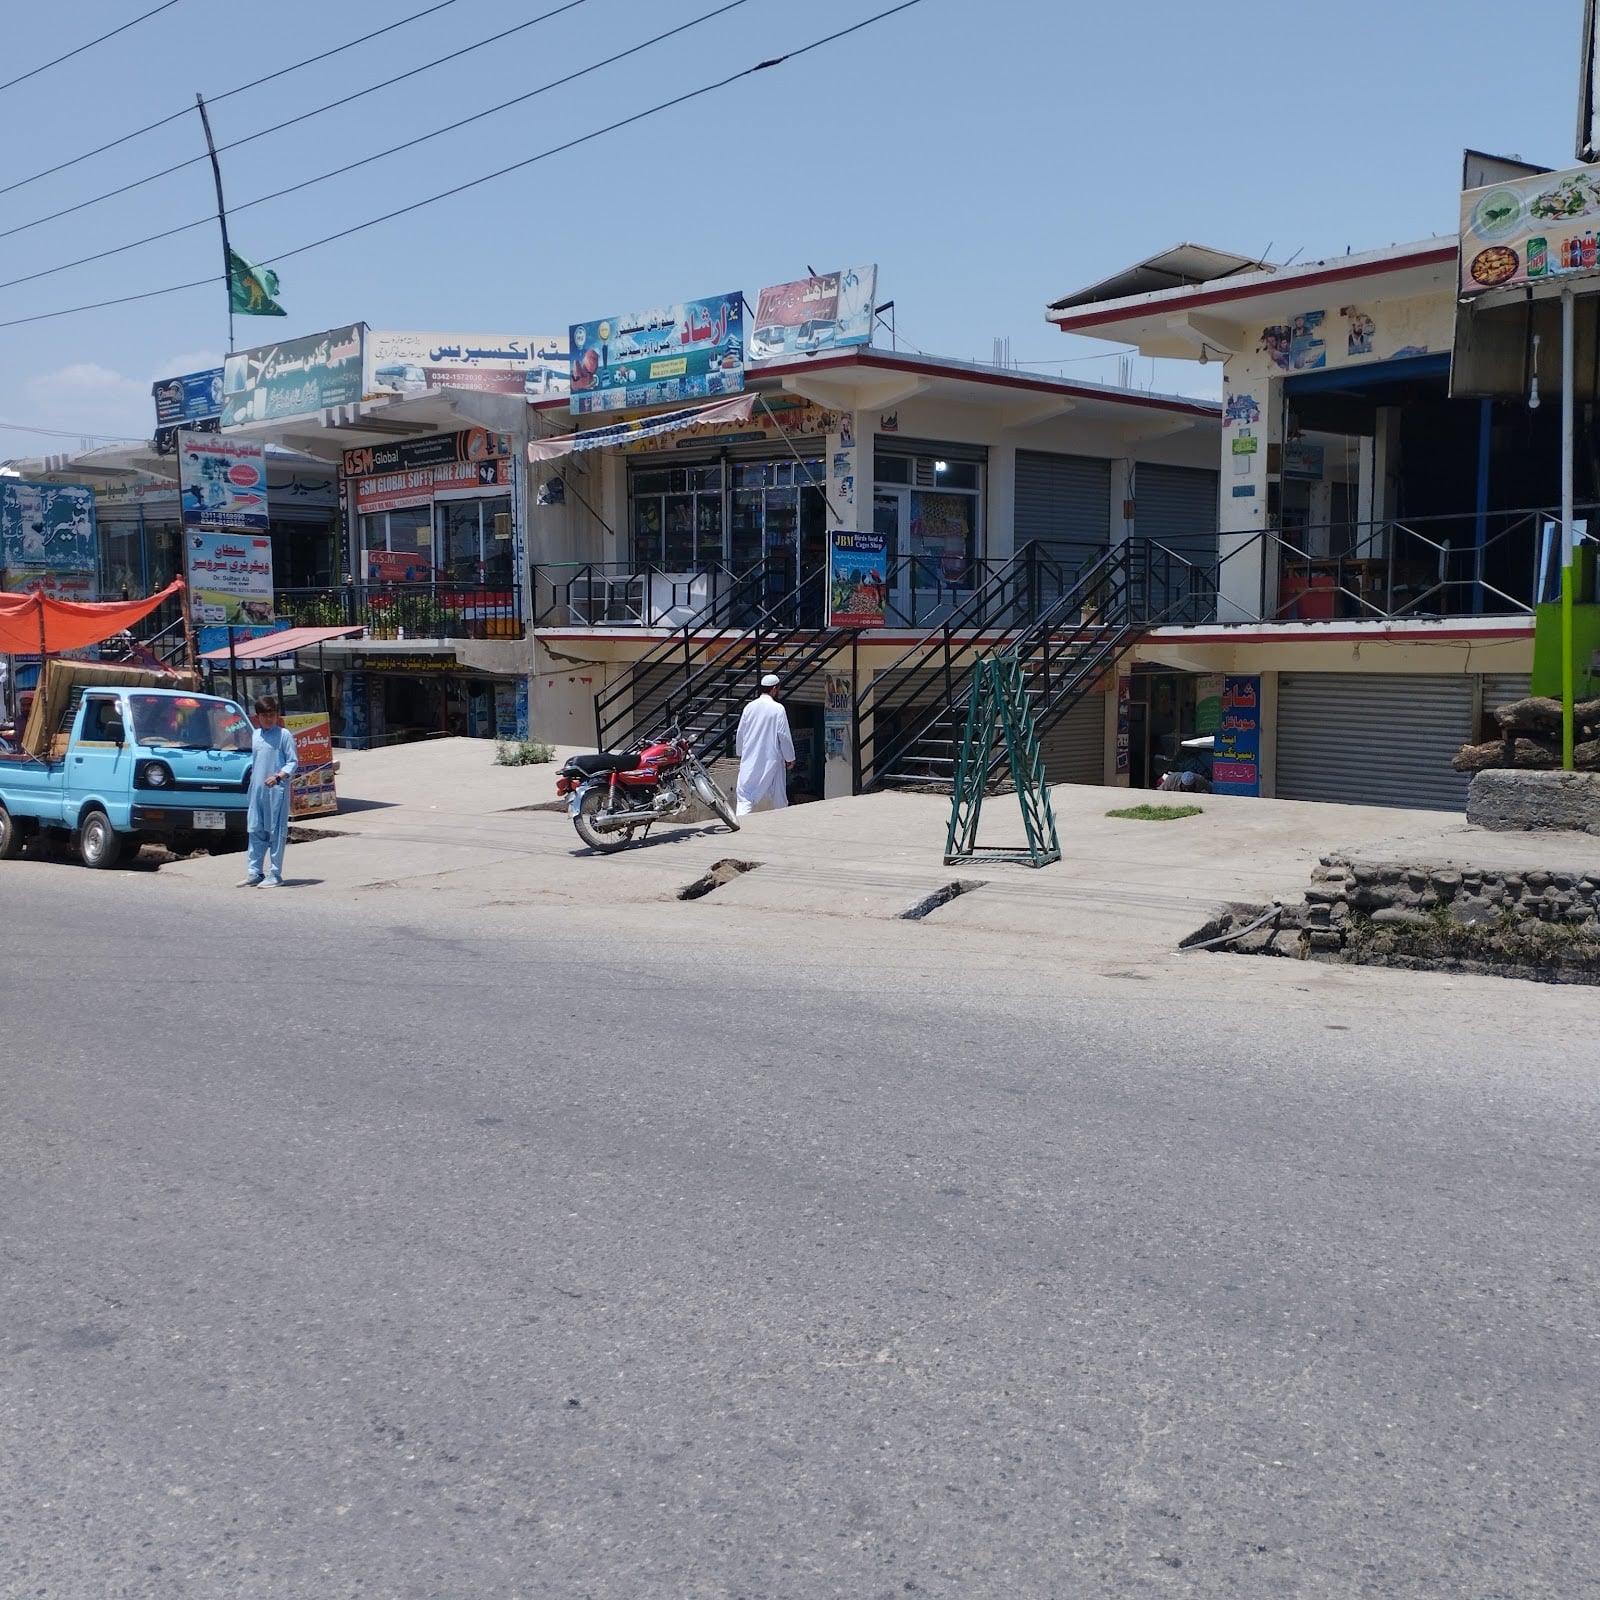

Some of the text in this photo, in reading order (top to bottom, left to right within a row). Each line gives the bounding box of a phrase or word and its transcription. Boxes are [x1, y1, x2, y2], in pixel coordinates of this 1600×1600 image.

[802, 278, 838, 302] شاہد
[680, 304, 728, 346] ارشاد
[303, 339, 329, 373] گلاس
[429, 341, 535, 367] ایکسپریس
[359, 479, 377, 496] GSM
[377, 473, 407, 492] GLOBAL
[408, 464, 453, 488] SOFTWARE
[454, 462, 477, 480] ZONE
[215, 544, 246, 558] سلطان
[835, 534, 854, 547] JBM
[1222, 715, 1256, 732] موبائل
